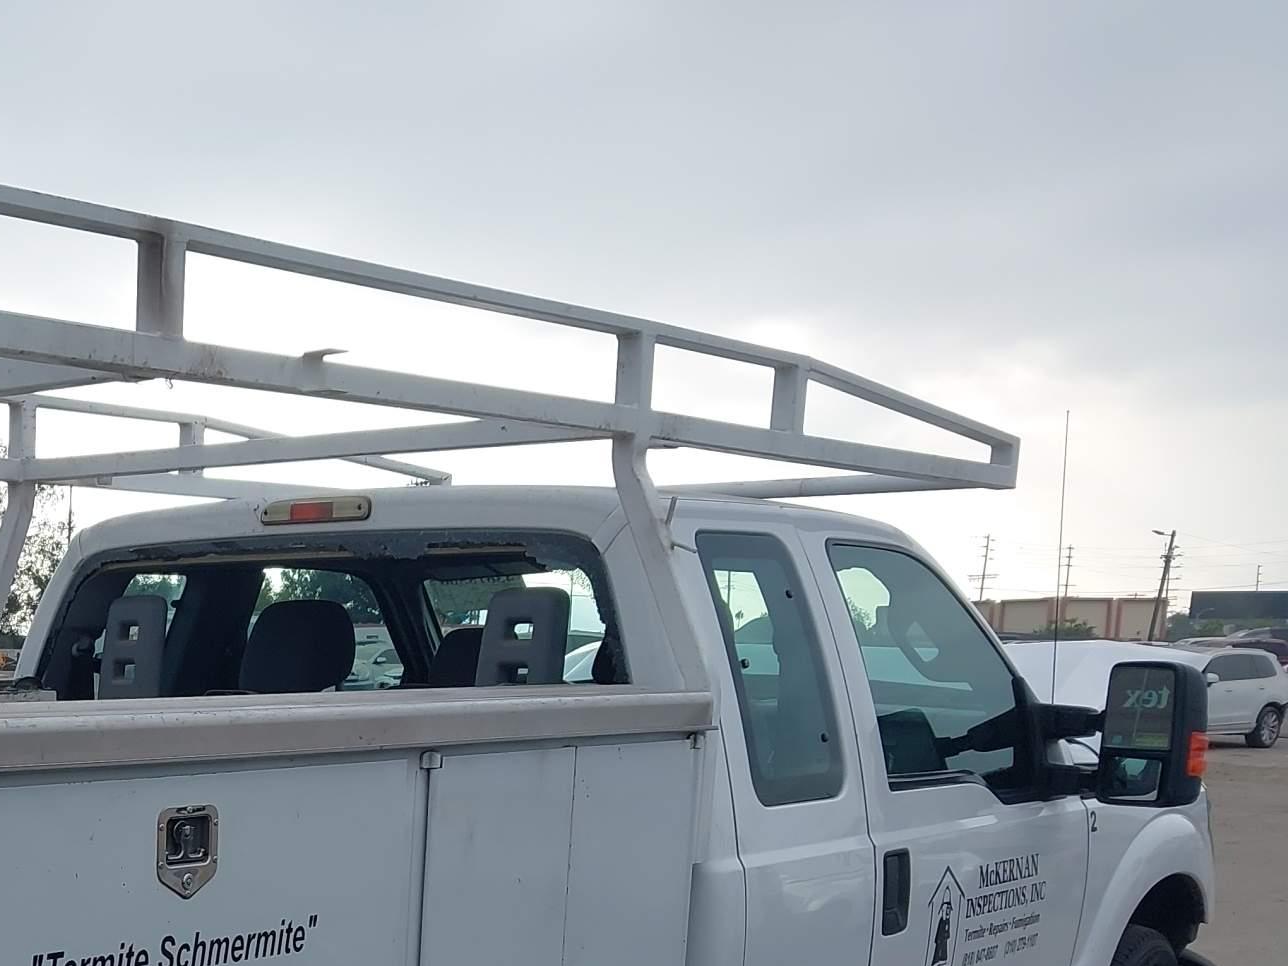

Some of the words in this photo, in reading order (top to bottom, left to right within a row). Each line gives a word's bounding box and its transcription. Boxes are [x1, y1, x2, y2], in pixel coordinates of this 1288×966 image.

[1090, 810, 1098, 833] 2
[978, 853, 1040, 889] McKERNAN
[965, 885, 1029, 919] INSPECTIONS,
